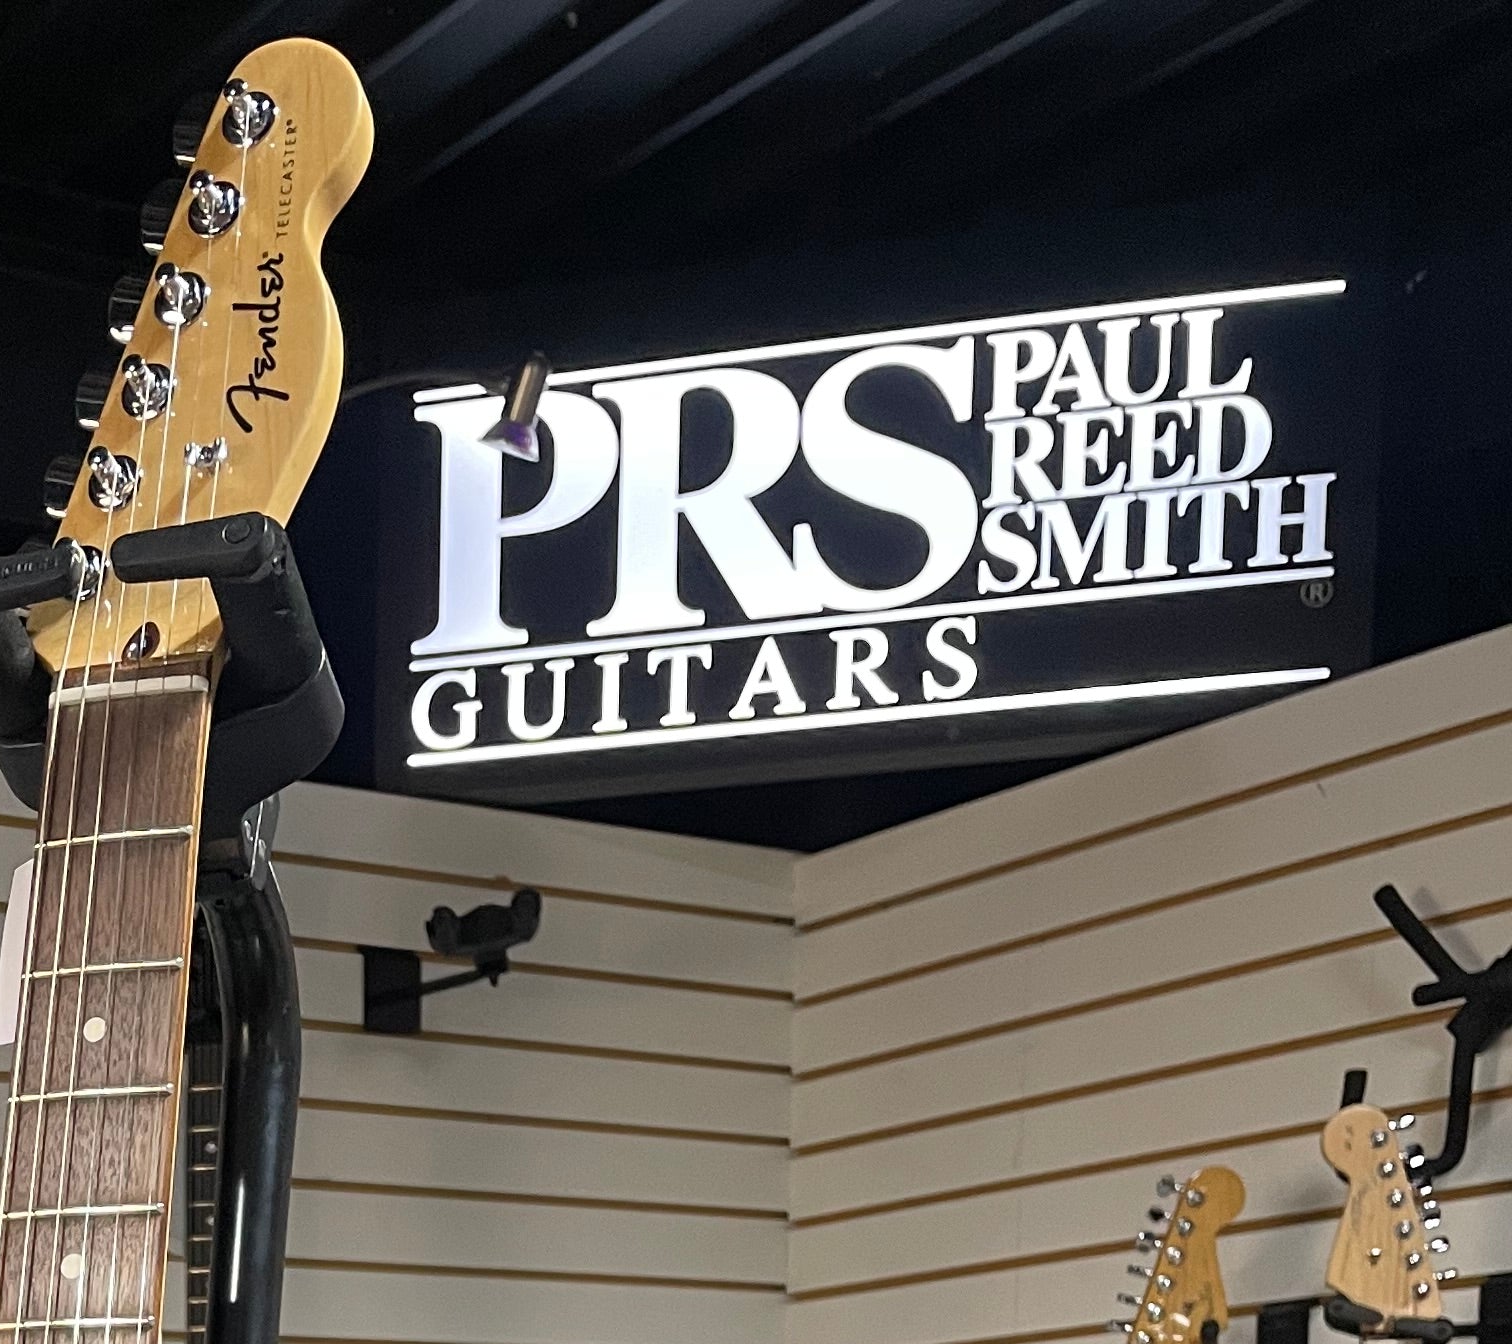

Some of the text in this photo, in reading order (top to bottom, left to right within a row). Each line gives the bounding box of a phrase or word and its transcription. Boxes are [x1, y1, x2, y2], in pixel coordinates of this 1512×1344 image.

[275, 120, 297, 239] TELECASTER
[227, 252, 289, 433] Fender
[985, 308, 1254, 422] PAUL
[412, 335, 980, 656] PRS
[982, 395, 1274, 509] REED
[977, 472, 1337, 596] SMITH
[409, 617, 979, 752] GUITARS
